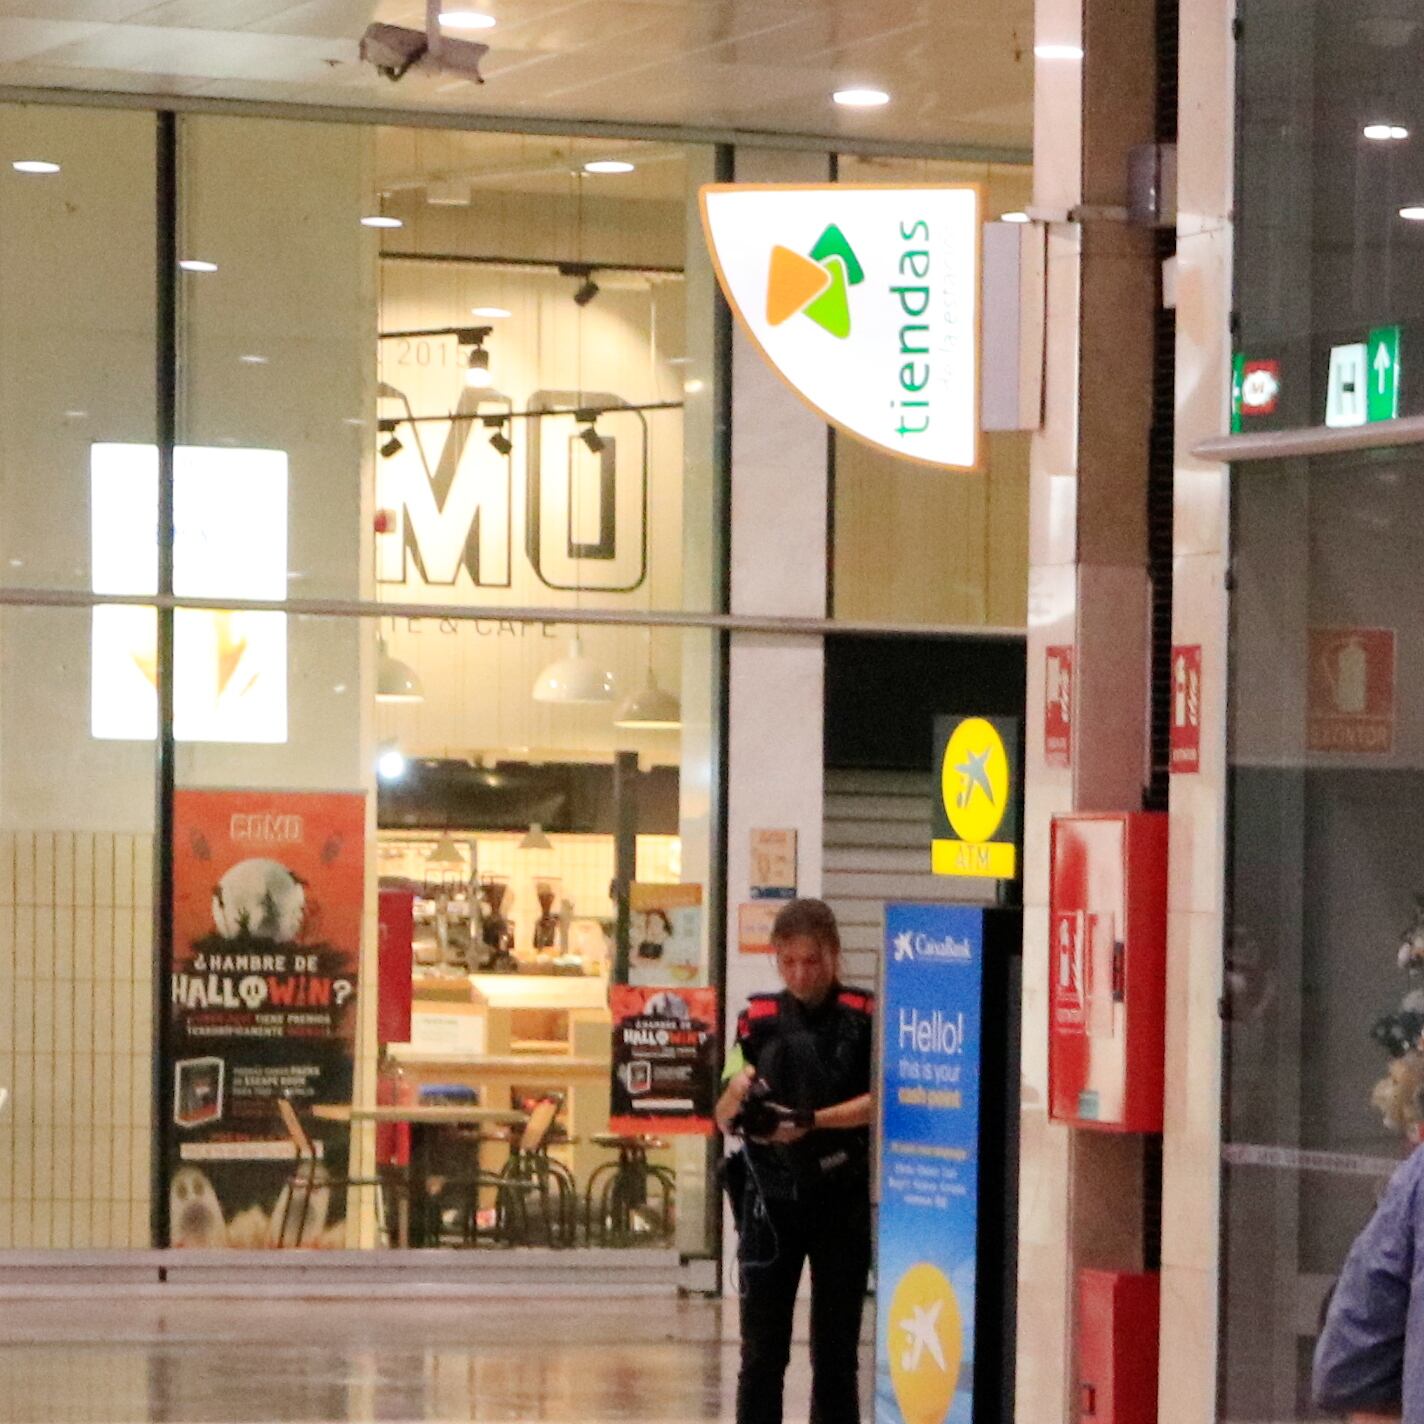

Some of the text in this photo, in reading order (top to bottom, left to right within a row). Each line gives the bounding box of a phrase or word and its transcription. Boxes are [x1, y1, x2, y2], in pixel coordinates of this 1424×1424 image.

[889, 219, 930, 438] tiendas
[955, 844, 993, 870] ATM
[294, 954, 319, 973] DE
[898, 1008, 963, 1056] Hello!
